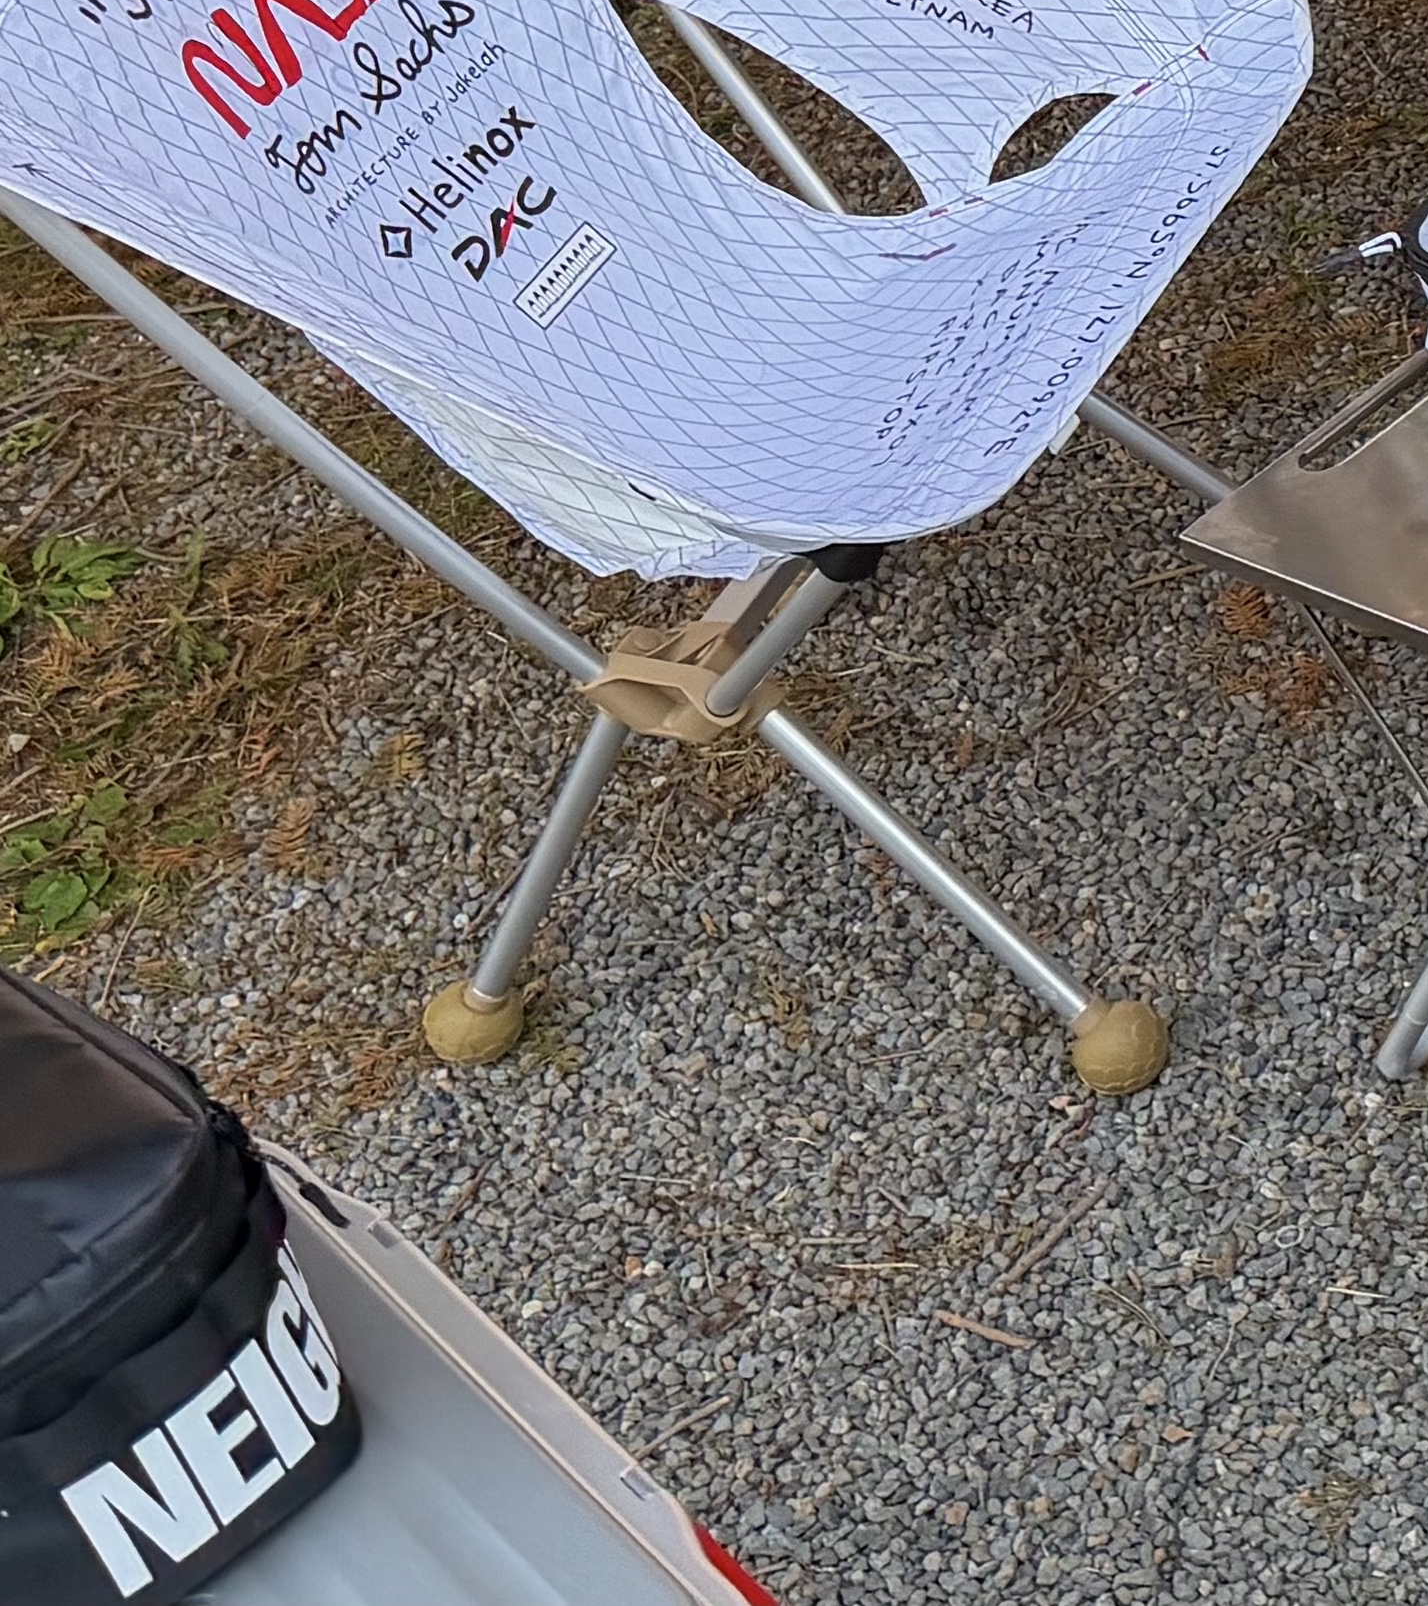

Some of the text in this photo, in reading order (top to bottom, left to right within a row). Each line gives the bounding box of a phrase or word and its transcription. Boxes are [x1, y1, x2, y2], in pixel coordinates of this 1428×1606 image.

[264, 109, 362, 194] Tom
[324, 126, 420, 229] ARCHITECTURE
[421, 100, 443, 125] BY
[399, 106, 536, 234] Helinox
[451, 176, 557, 282] DAC
[60, 1239, 343, 1598] NEIG
